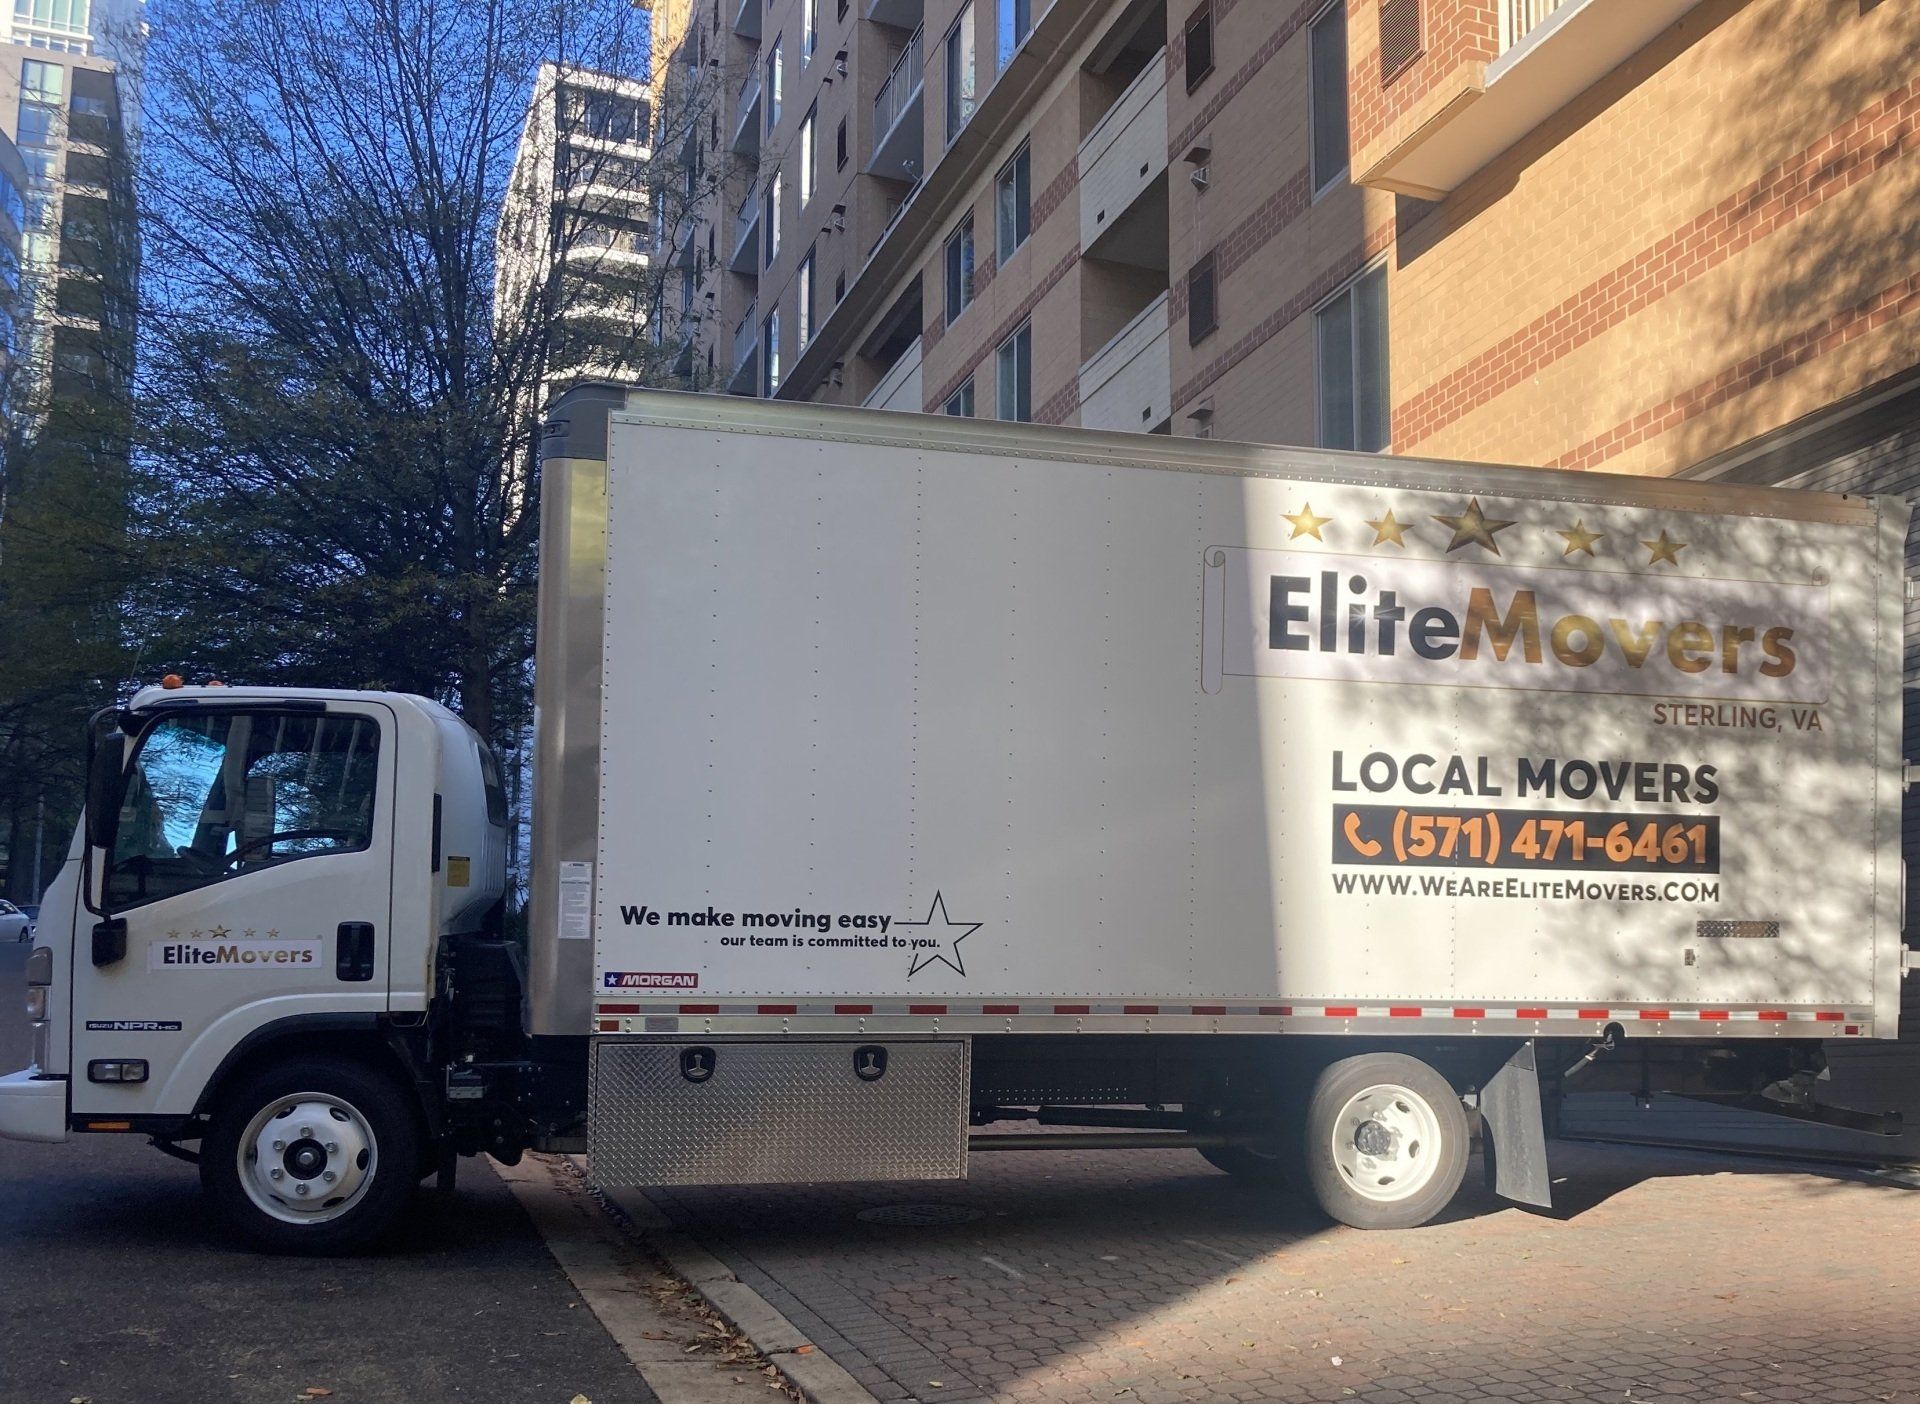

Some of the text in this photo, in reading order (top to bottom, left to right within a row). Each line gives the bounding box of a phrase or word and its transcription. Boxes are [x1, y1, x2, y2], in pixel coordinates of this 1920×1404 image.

[1269, 571, 1797, 678] EliteMovers
[1653, 703, 1823, 733] STERLING, VA
[1332, 750, 1720, 804] LOCAL MOVERS
[1392, 808, 1707, 865] (571) 471-6461
[620, 905, 892, 933] We make moving easy
[163, 944, 313, 965] EliteMovers
[720, 934, 941, 951] our team is committed to you.
[621, 974, 695, 987] MORGAN
[113, 1021, 158, 1030] NPR
